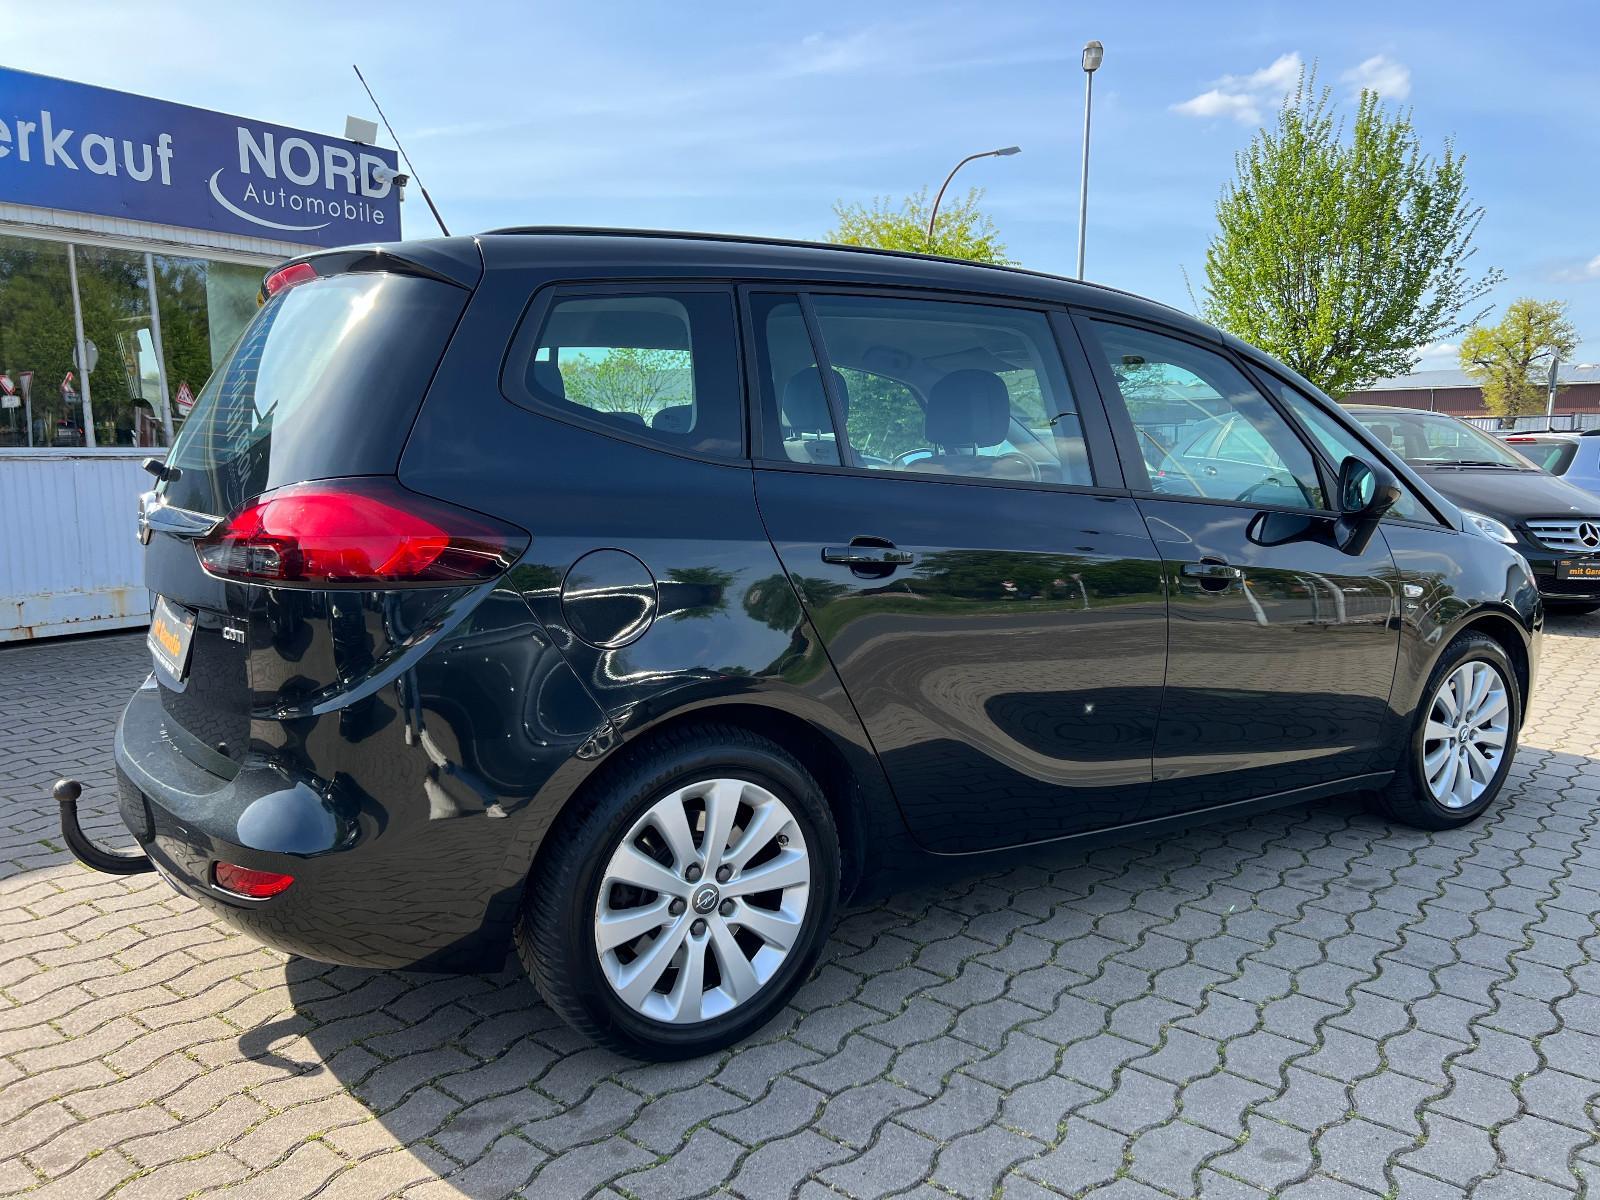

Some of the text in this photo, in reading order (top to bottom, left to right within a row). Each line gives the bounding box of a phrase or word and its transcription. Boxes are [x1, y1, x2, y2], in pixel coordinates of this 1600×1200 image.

[237, 127, 392, 199] NORD
[243, 182, 385, 225] Automobile
[1569, 567, 1584, 575] mit
